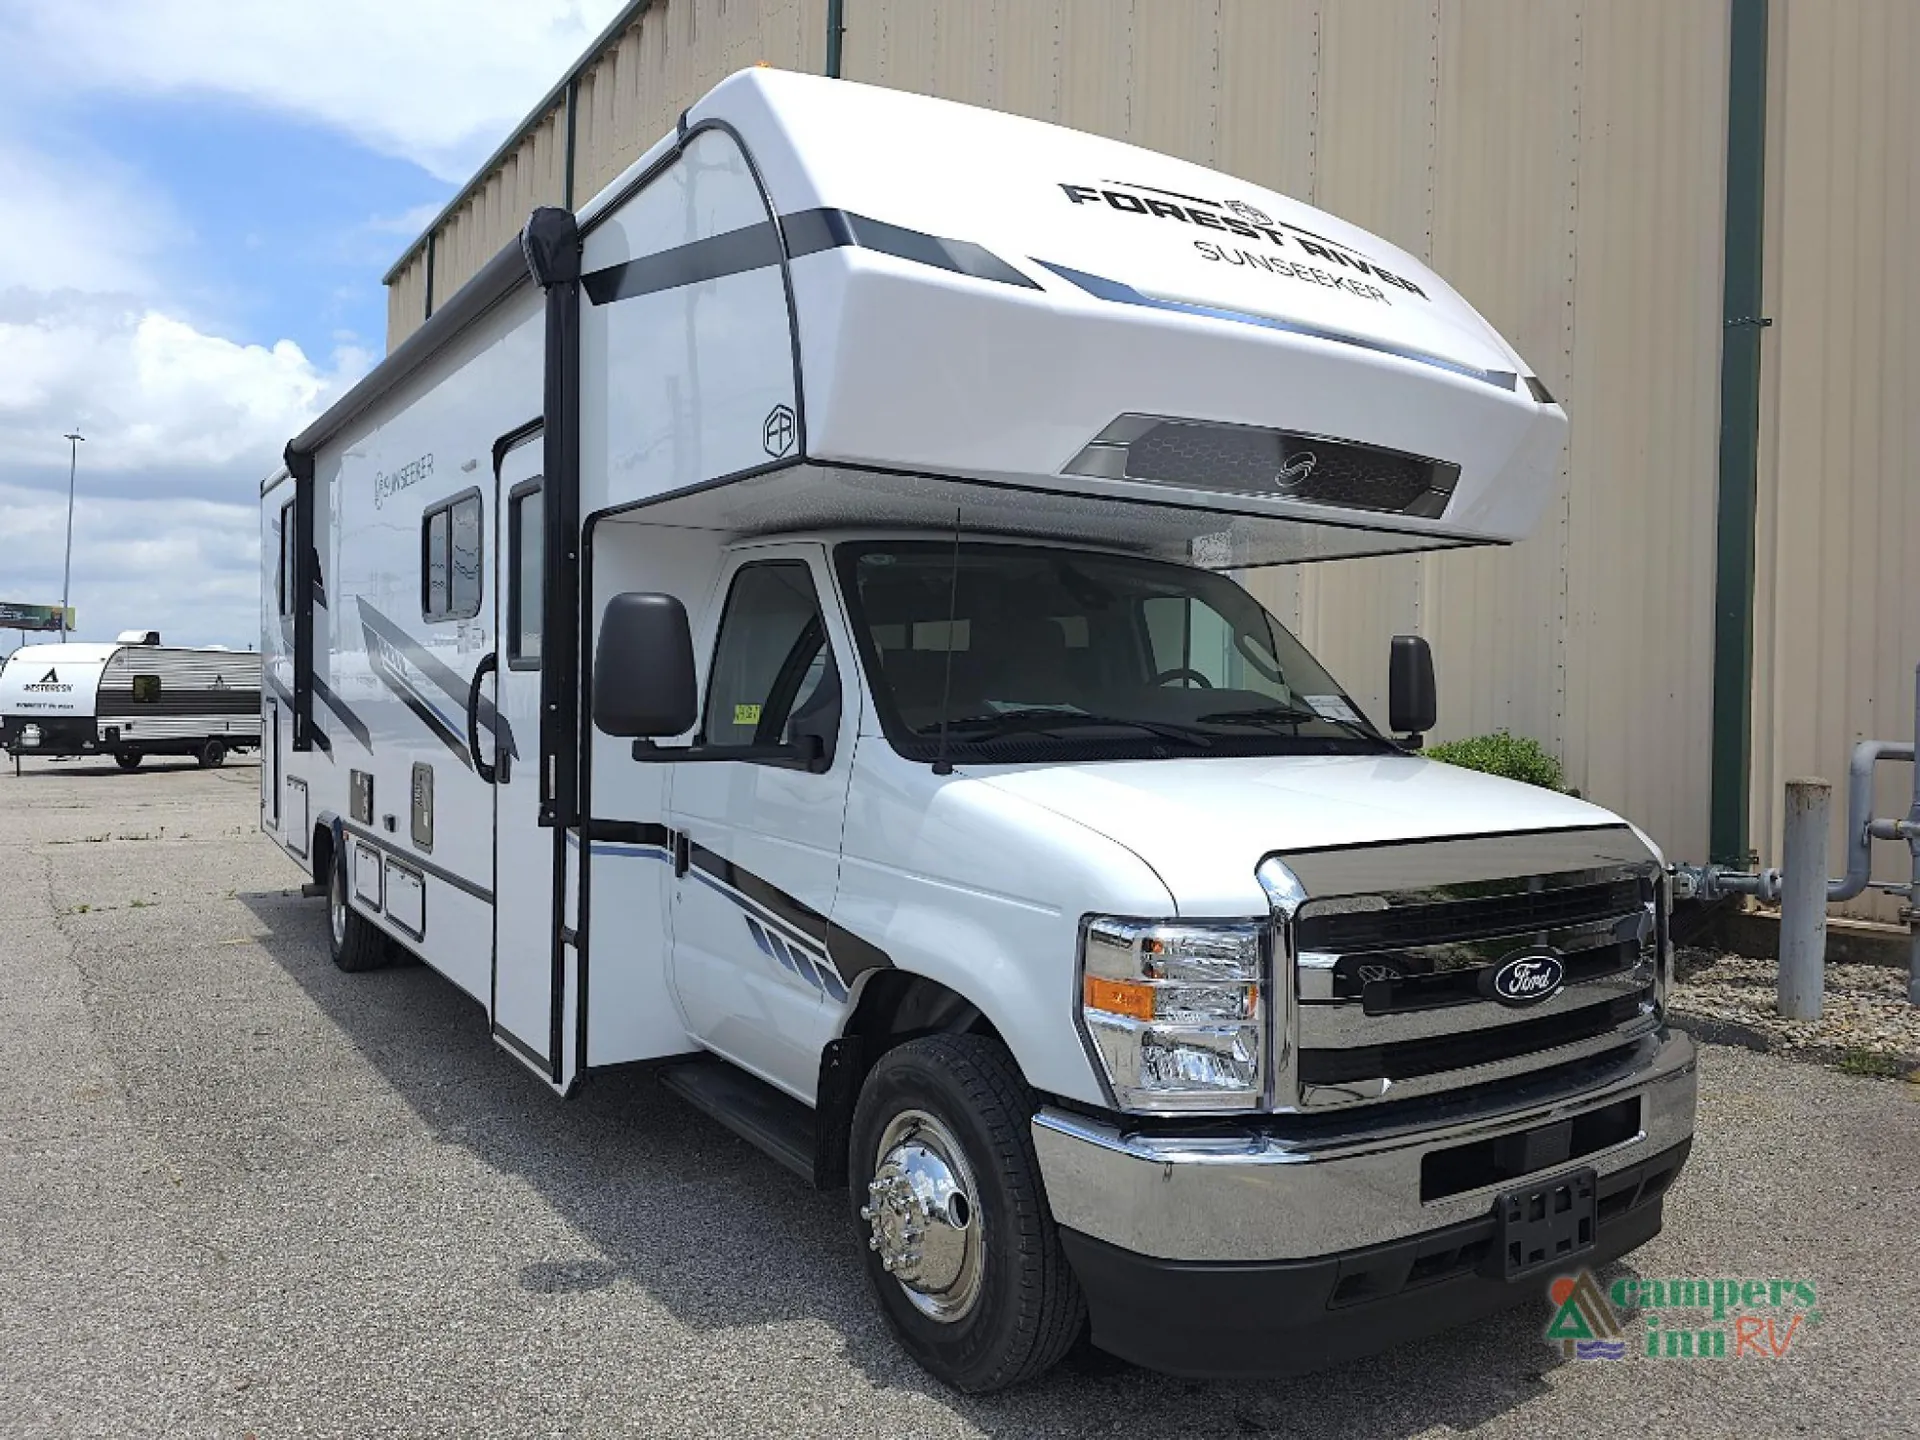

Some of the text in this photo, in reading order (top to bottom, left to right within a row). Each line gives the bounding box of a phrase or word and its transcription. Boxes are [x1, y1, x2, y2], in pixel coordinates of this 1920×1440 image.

[1057, 183, 1431, 302] FOREST RIVER
[1193, 240, 1392, 306] SUNSEEKER
[1508, 961, 1552, 994] Ford
